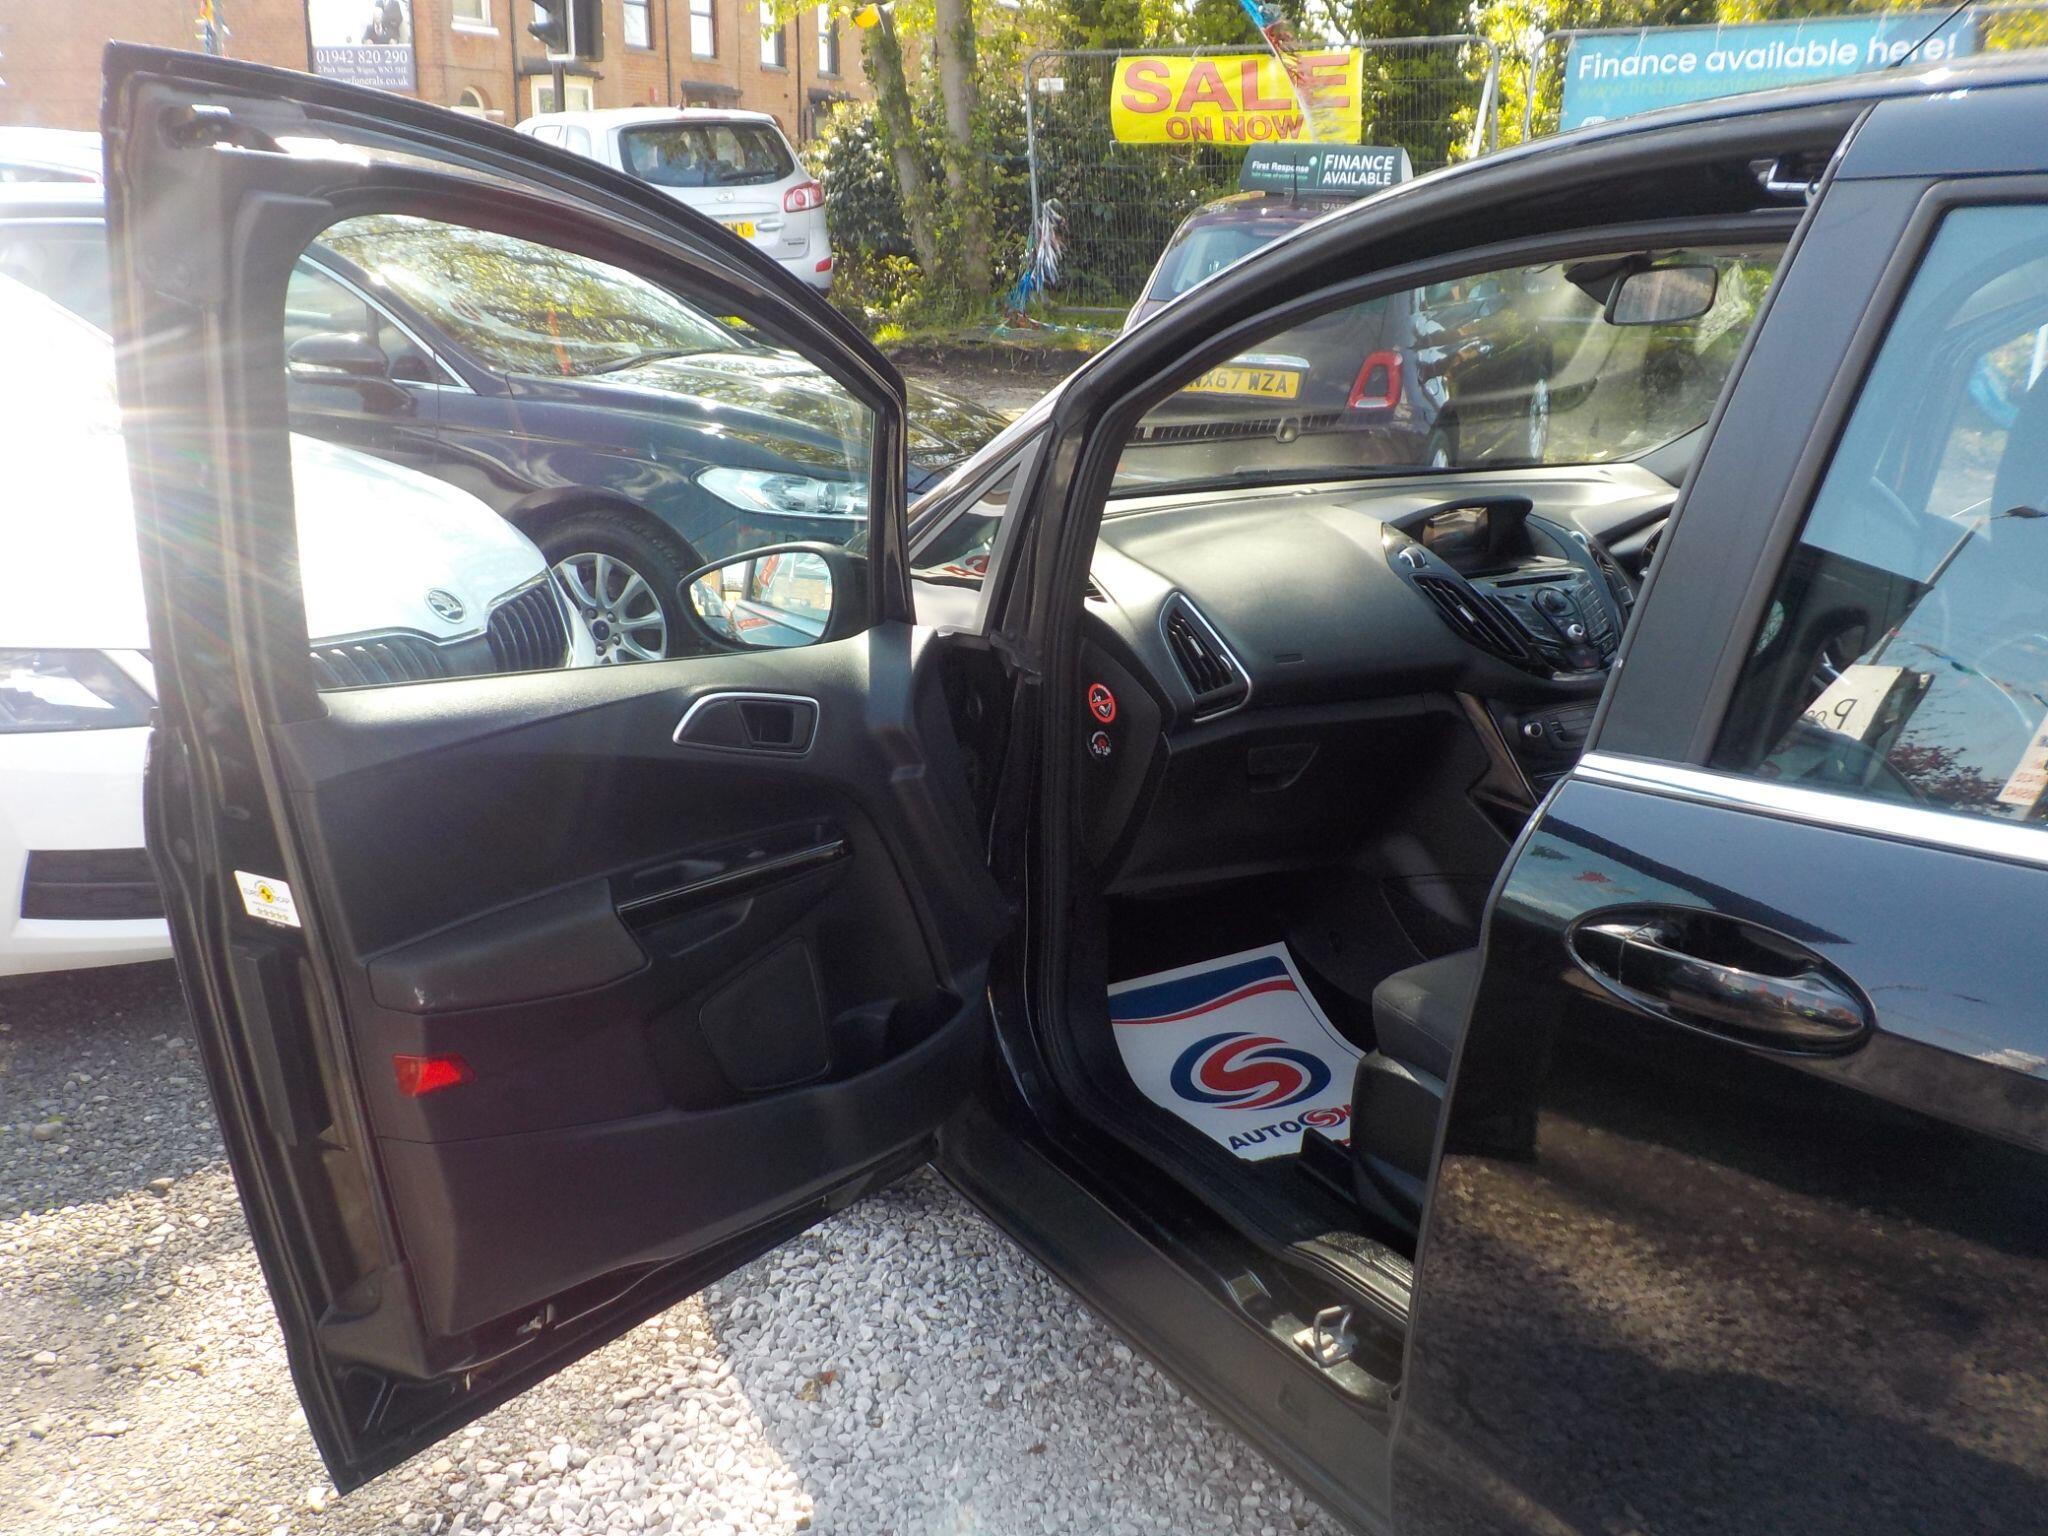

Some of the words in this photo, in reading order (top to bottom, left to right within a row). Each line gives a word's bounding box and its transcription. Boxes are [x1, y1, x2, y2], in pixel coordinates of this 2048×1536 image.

[316, 50, 354, 64] 01942
[358, 50, 381, 64] 820
[385, 50, 408, 64] 290
[1577, 50, 1697, 80] Finance
[1704, 37, 1858, 73] available
[1865, 32, 1957, 65] here!
[1121, 55, 1350, 113] SALE
[1165, 117, 1213, 142] ON
[1224, 115, 1305, 142] NOW
[1252, 161, 1270, 171] First
[1271, 162, 1310, 173] Response
[1323, 154, 1395, 172] FINANCE
[1322, 171, 1392, 186] AVAILABLE
[1248, 372, 1288, 394] WZA
